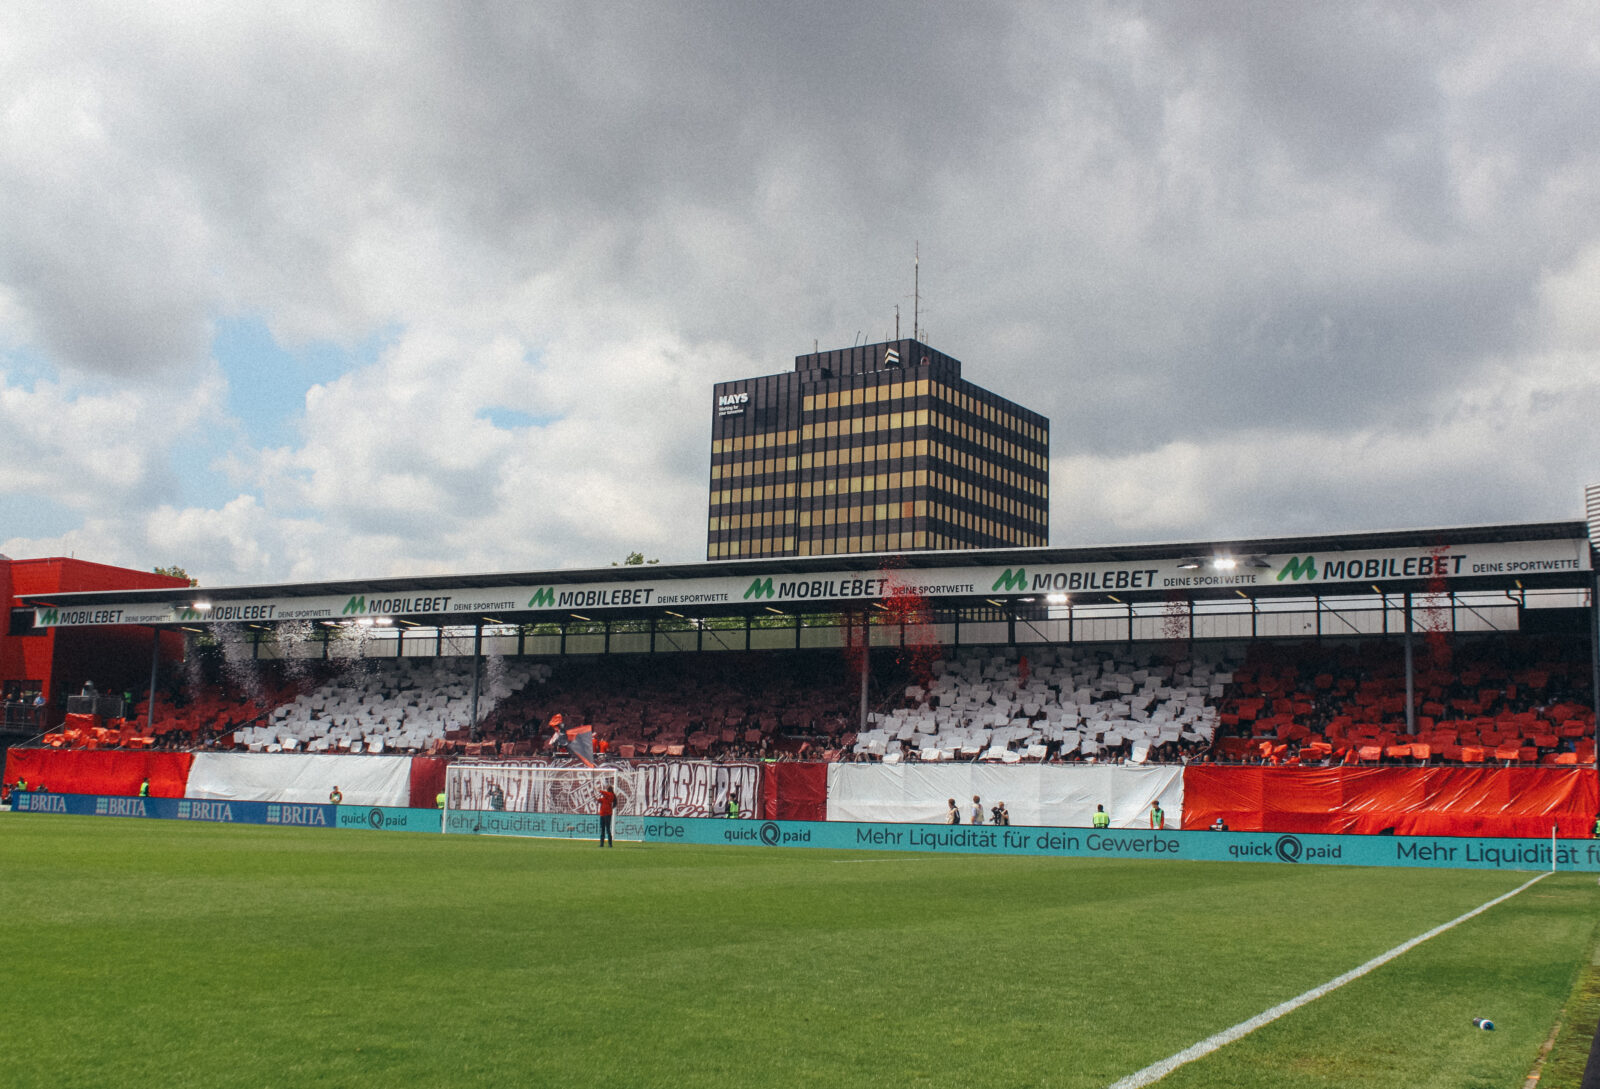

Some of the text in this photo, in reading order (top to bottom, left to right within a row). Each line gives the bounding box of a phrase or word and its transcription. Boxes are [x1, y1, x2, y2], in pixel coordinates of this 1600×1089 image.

[719, 393, 748, 406] HAYS
[1323, 555, 1579, 580] MOBILEBET DEINE SPORTWETTE
[779, 579, 888, 598] MOBILEBET
[918, 584, 974, 594] SPORTWETTE
[1032, 569, 1257, 591] MOBILEBET DEINE SPORTWETTE
[368, 597, 515, 613] MOBILEBET DEINE SPORTWETTE
[558, 588, 728, 607] MOBILEBET DEINE SPORTWETTE
[60, 610, 123, 624] MOBILEBET
[204, 605, 276, 620] MOBILEBET
[294, 609, 331, 618] SPORTWETTE
[30, 794, 67, 812] BRITA
[109, 798, 147, 816] BRITA
[191, 801, 233, 821] BRITA
[282, 805, 326, 825] BRITA
[341, 812, 367, 827] quick
[385, 814, 407, 828] paid
[576, 819, 602, 833] dei
[615, 821, 685, 838] Gewerbe
[724, 827, 758, 841] quick
[783, 830, 811, 845] paid
[856, 827, 1180, 853] Mehr Liquidität für dein Gewerbe
[1228, 842, 1273, 858] quick
[1306, 844, 1342, 861] paid
[1396, 841, 1458, 862] Mehr
[1465, 842, 1580, 868] Liquidität
